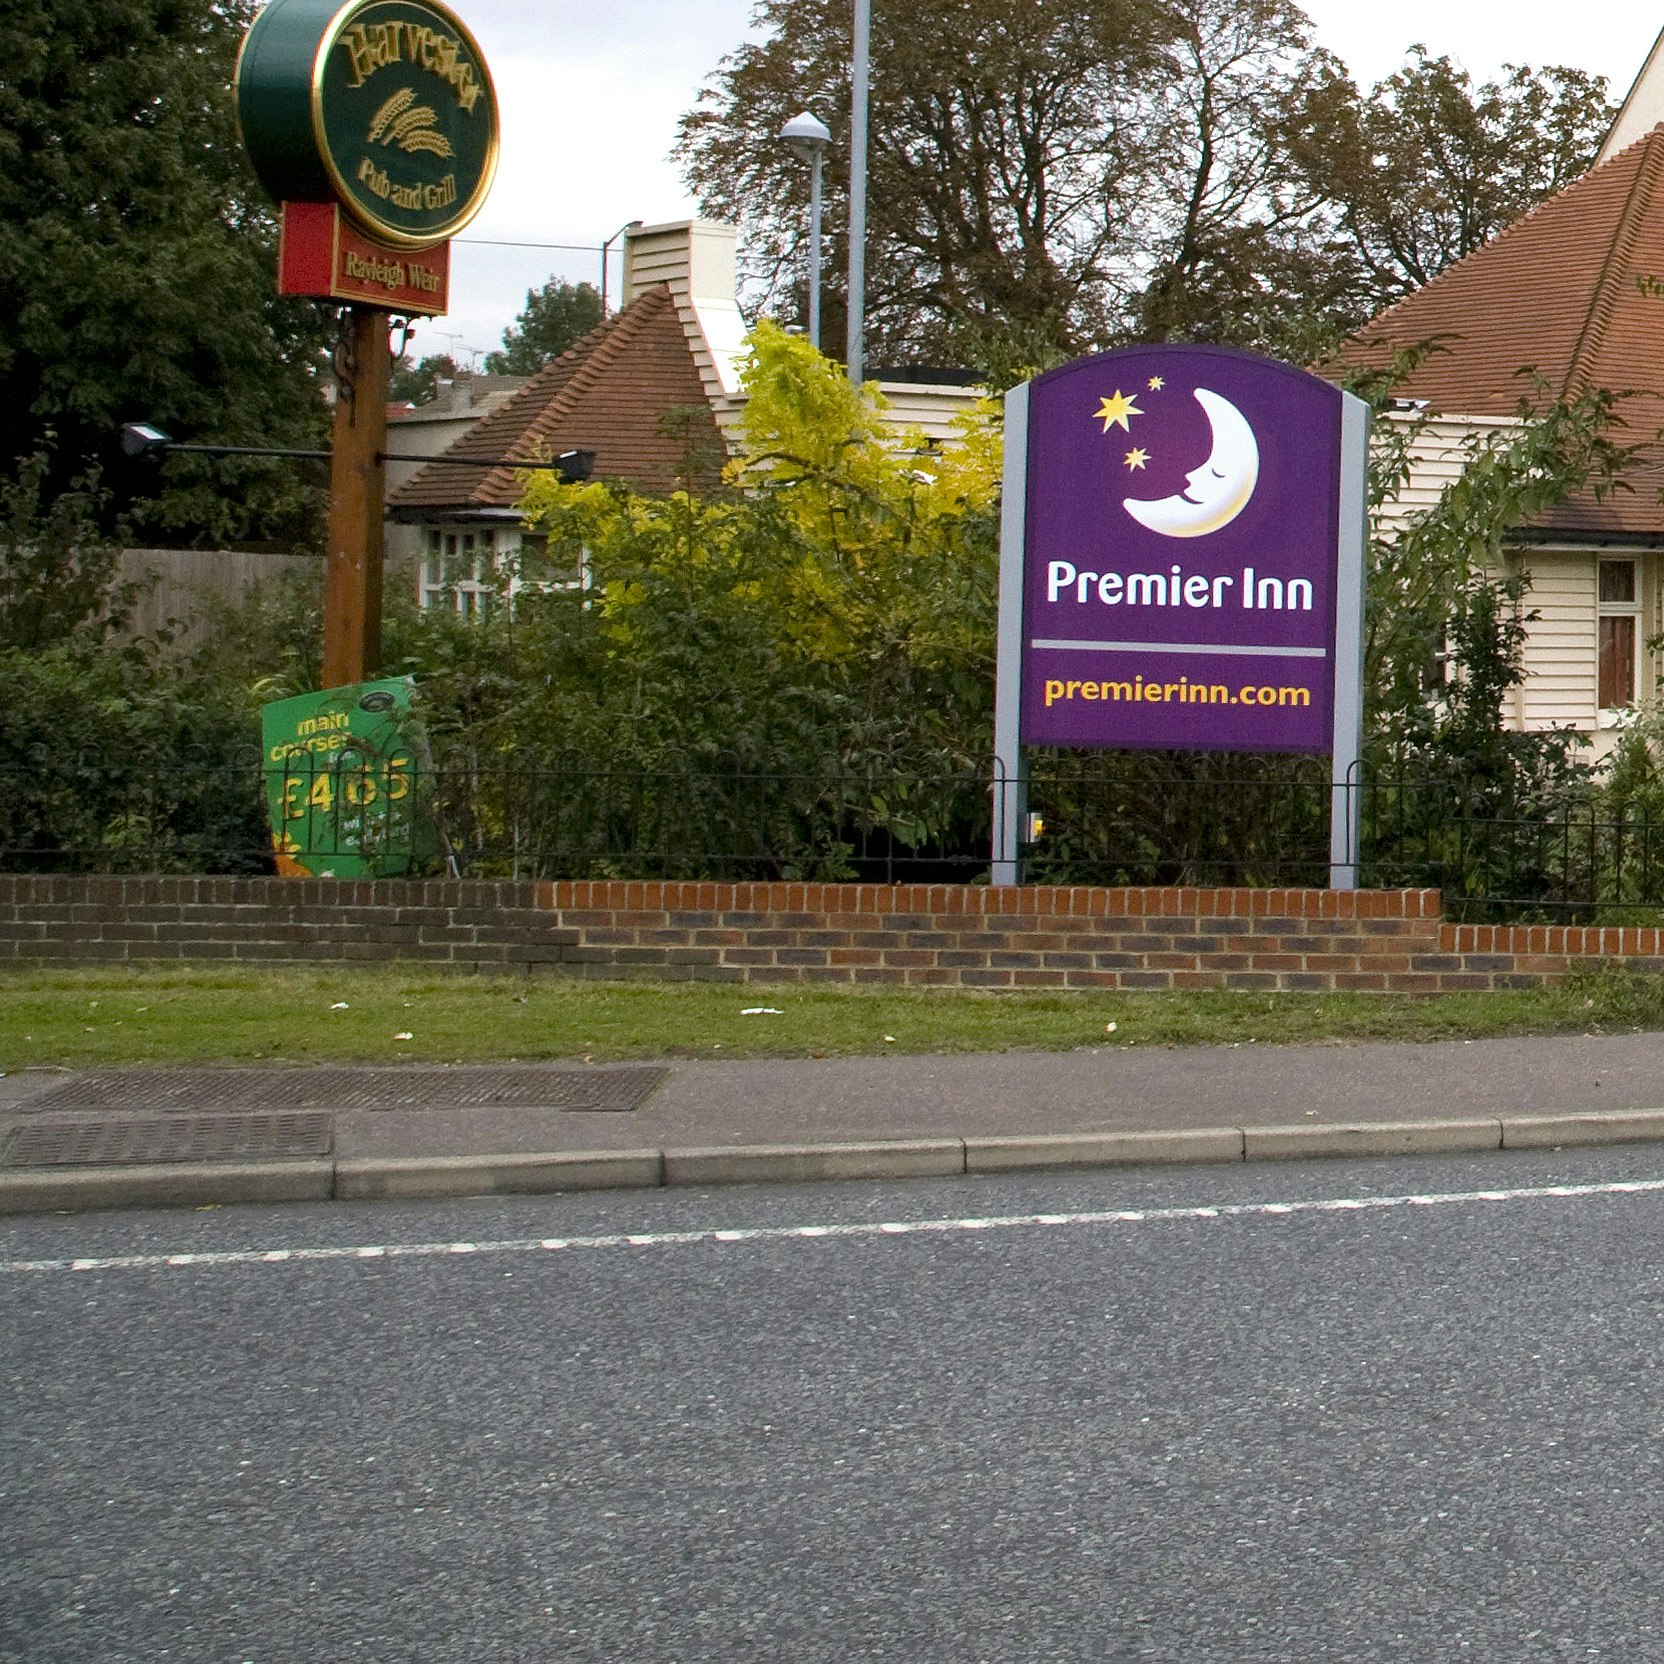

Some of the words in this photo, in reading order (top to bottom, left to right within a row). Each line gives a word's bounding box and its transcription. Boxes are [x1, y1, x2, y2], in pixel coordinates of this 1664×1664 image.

[390, 182, 422, 211] and
[423, 174, 457, 210] Grill
[345, 251, 406, 290] Rayleigh
[1047, 560, 1233, 608] Premier
[1243, 567, 1313, 611] Inn
[1044, 674, 1311, 706] premierinn.com
[297, 710, 350, 736] main
